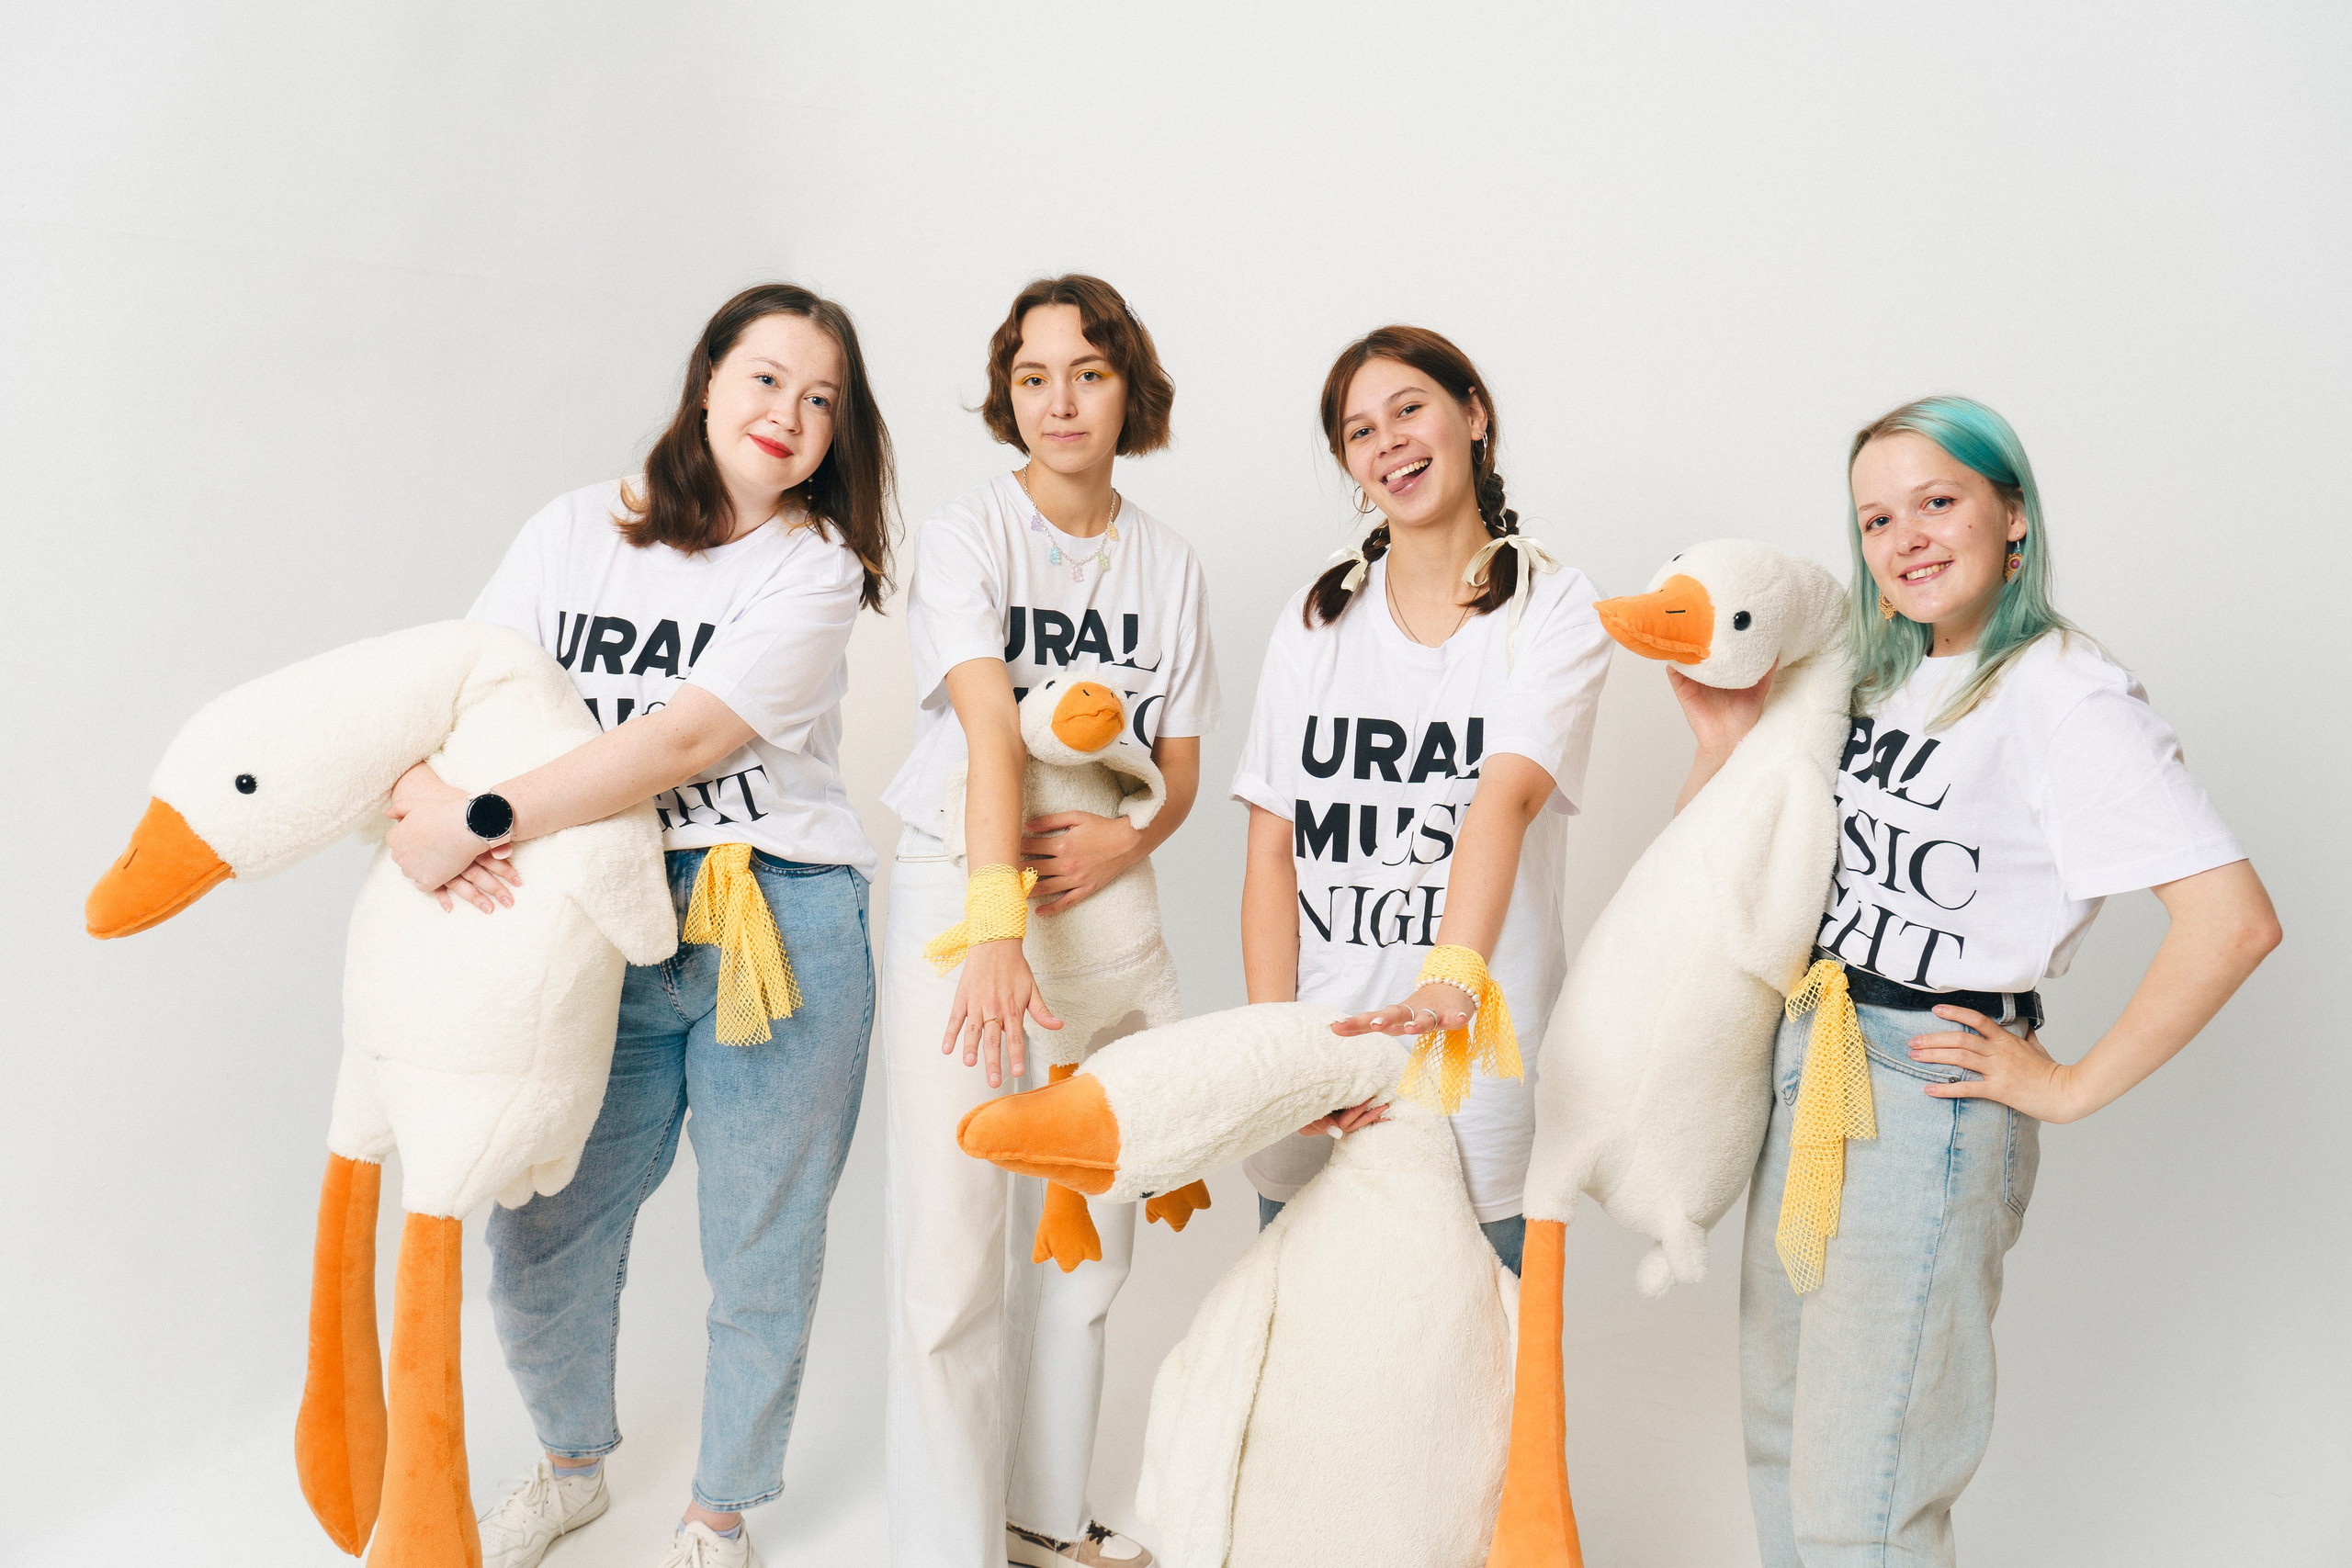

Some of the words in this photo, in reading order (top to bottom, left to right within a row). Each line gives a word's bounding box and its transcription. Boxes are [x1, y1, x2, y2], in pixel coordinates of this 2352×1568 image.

[1839, 716, 1951, 811] RAL
[1295, 798, 1471, 866] MUS
[1833, 795, 1980, 910] SIC
[1297, 885, 1445, 949] NIGH
